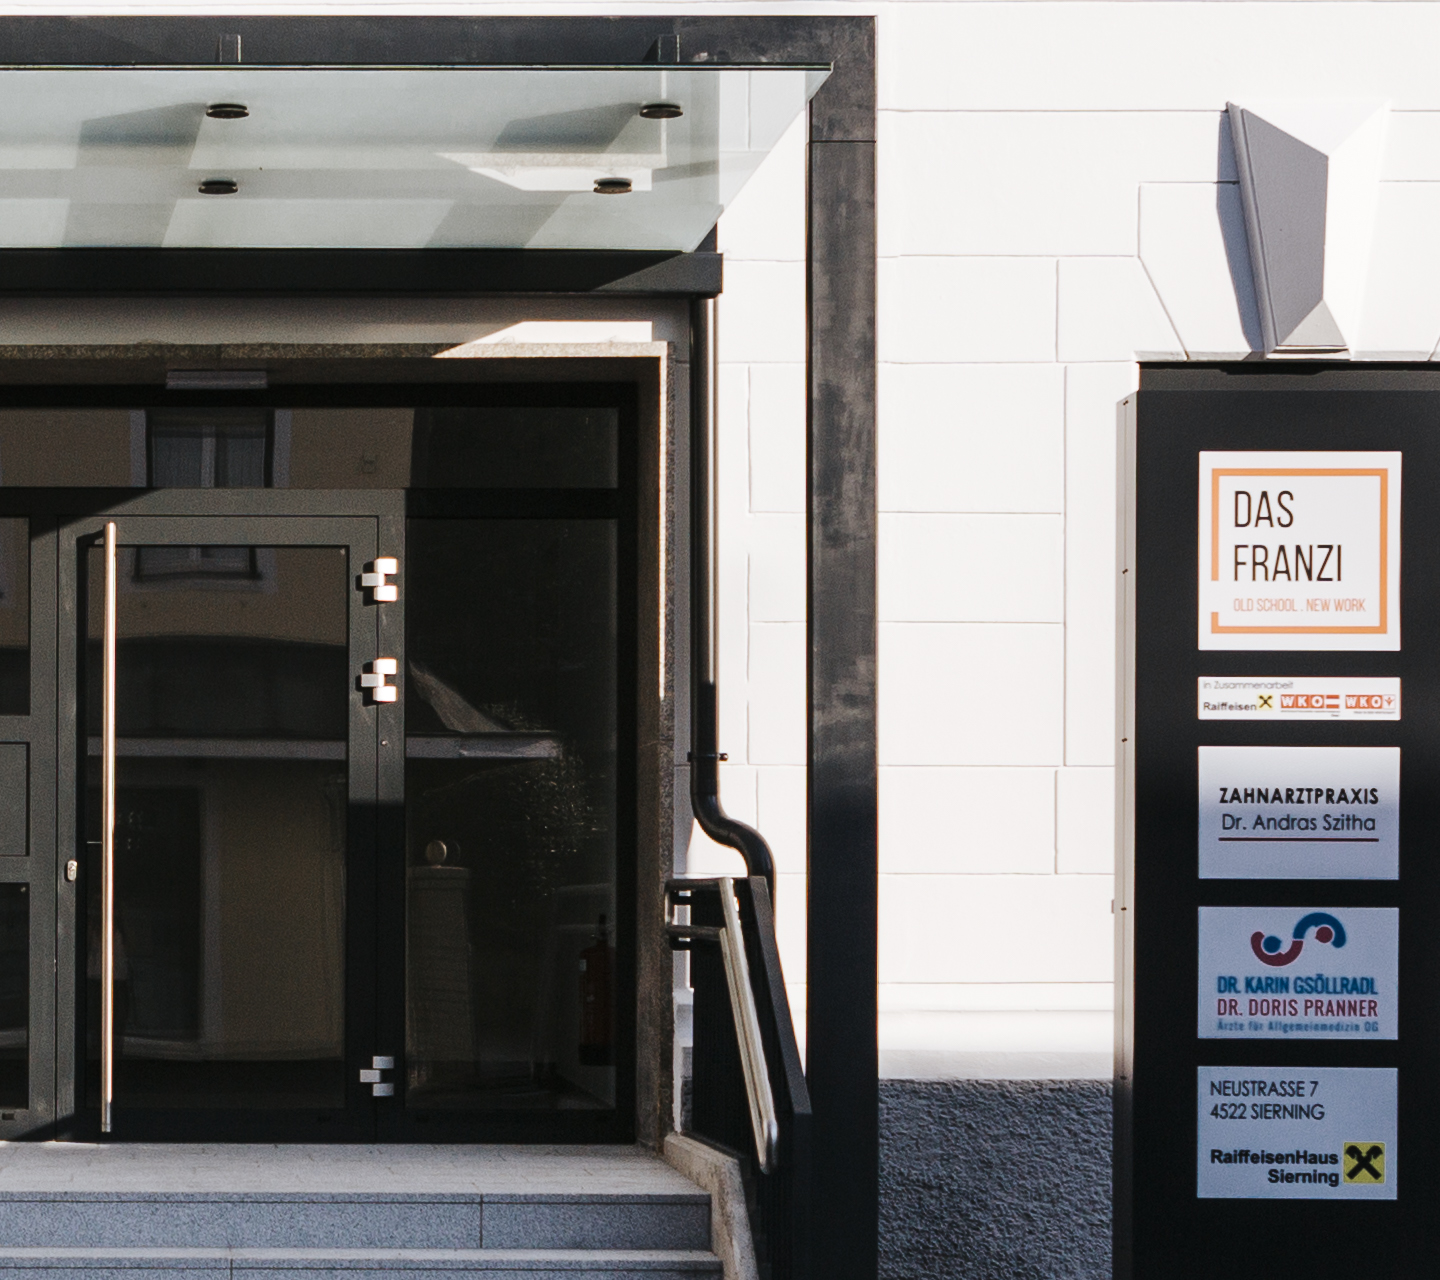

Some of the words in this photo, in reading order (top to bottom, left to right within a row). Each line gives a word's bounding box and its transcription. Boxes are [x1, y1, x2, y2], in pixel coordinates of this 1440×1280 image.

[1234, 490, 1295, 528] DAS
[1234, 544, 1342, 582] FRANZI
[1233, 598, 1254, 612] OLD
[1256, 598, 1298, 612] SCHOOL
[1306, 598, 1331, 612] NEW
[1334, 598, 1366, 612] WORK
[1214, 681, 1294, 690] Zusammenarbeit
[1203, 701, 1257, 711] Raiffeisen
[1281, 695, 1324, 708] WKO
[1345, 695, 1383, 708] WKO
[1219, 787, 1379, 804] ZAHNARZTPRAXIS
[1222, 813, 1247, 830] Dr.
[1252, 814, 1317, 831] Andras
[1323, 814, 1376, 831] Szitha
[1217, 976, 1241, 994] DR.
[1245, 976, 1290, 994] KARIN
[1294, 973, 1378, 995] GSÖLLRADL
[1217, 999, 1243, 1016] DR.
[1249, 999, 1298, 1016] DORIS
[1304, 999, 1378, 1017] PRANNER
[1248, 1021, 1264, 1032] für
[1268, 1020, 1360, 1033] Allgemeinmedizin
[1210, 1081, 1305, 1097] NEUSTRASSE
[1310, 1081, 1319, 1097] 7
[1210, 1104, 1247, 1120] 4522
[1250, 1104, 1325, 1120] SIERNING
[1210, 1149, 1339, 1165] RaiffeisenHaus
[1268, 1170, 1339, 1187] Sierning
